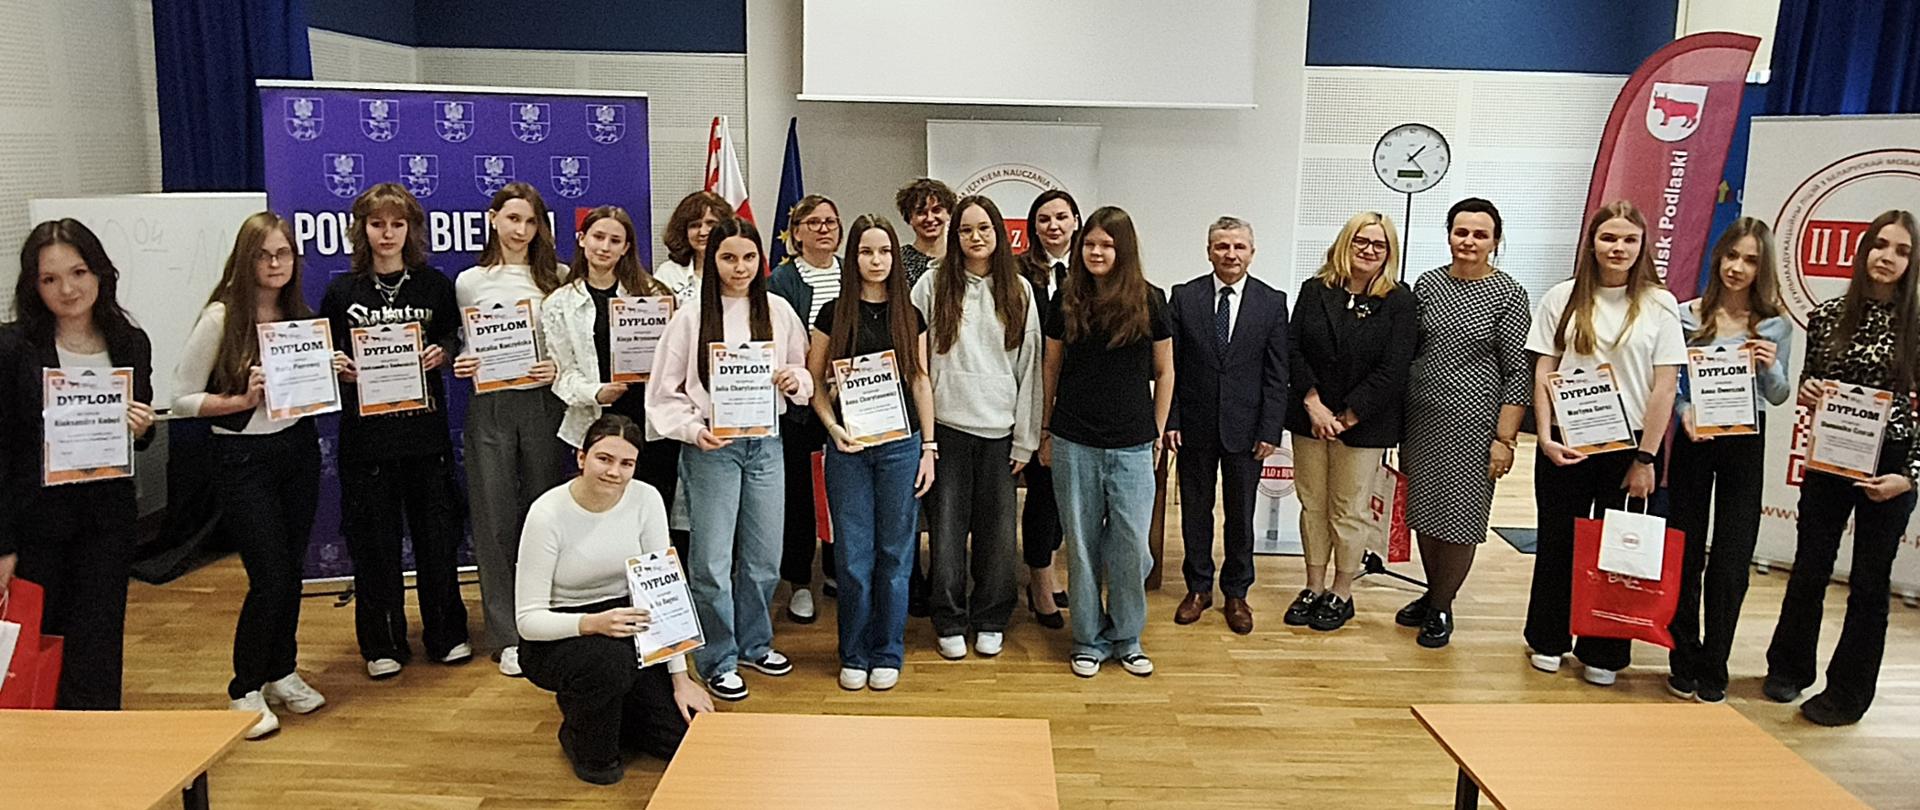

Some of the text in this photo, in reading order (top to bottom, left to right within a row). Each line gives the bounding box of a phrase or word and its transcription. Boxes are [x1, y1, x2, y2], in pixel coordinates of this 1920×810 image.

[1003, 168, 1051, 188] NAUCZANIA
[1658, 150, 1689, 231] Podlaski
[1807, 228, 1833, 265] II
[475, 320, 528, 336] DYPLOM
[619, 317, 667, 327] DYPLOM
[270, 341, 324, 356] DYPLOM
[363, 343, 414, 357] DYPLOM
[719, 364, 771, 375] DYPLOM
[1698, 365, 1748, 378] DYPLOM
[846, 372, 893, 389] DYPLOM
[57, 393, 123, 406] DYPLOM
[1560, 384, 1612, 401] DYPLOM
[1826, 402, 1879, 421] DYPLOM
